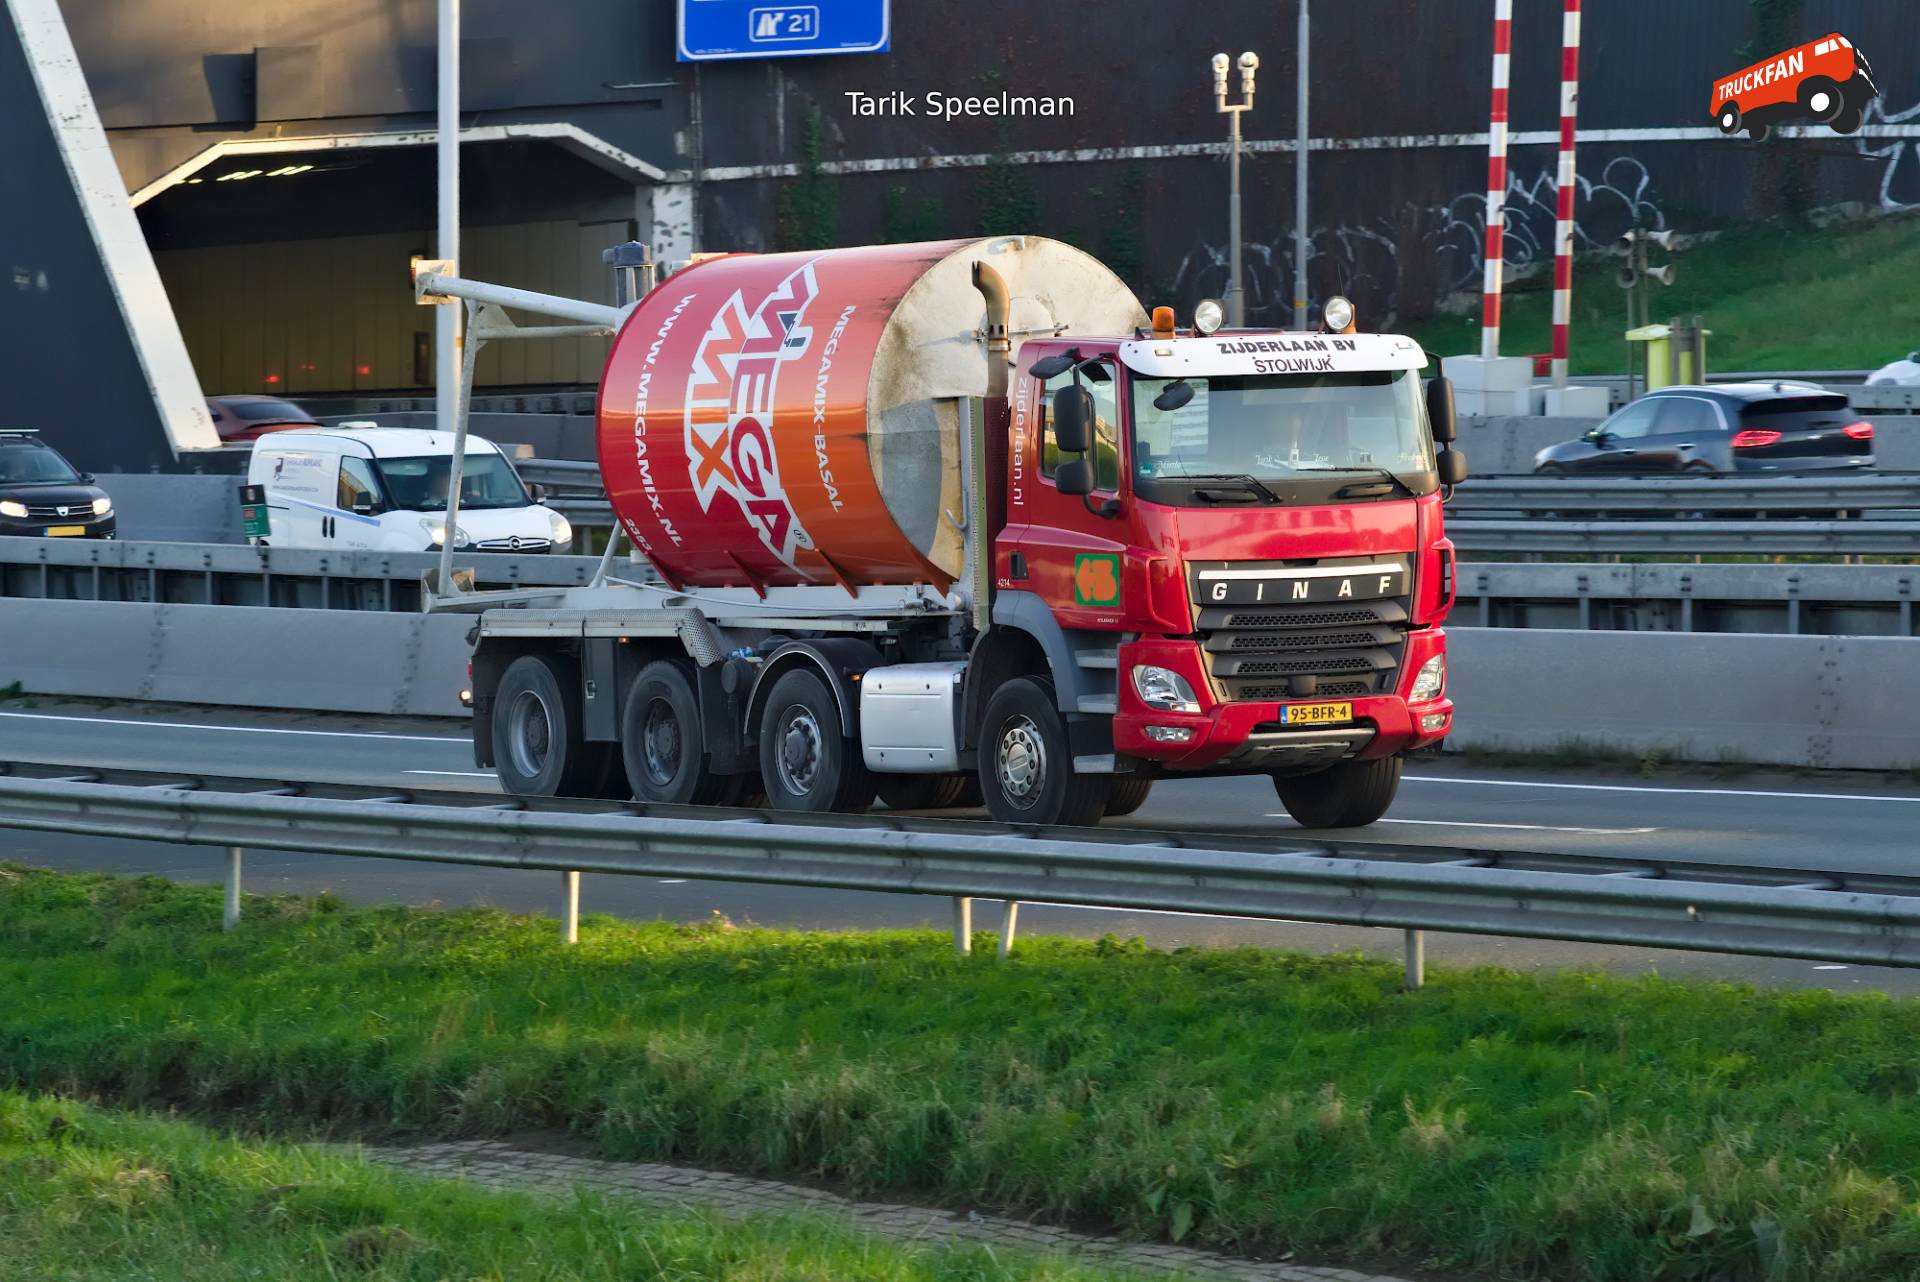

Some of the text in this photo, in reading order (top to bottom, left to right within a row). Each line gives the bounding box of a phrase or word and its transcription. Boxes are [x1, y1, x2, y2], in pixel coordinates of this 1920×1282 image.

[788, 14, 811, 33] 21
[1216, 339, 1356, 354] ZIJDERLAAN BV
[1254, 358, 1335, 373] STOLWIJK
[686, 290, 750, 514] MIX
[813, 305, 857, 513] MEGAMIX-BASAL
[634, 294, 696, 548] WWW.MEGAMIX.NL
[1013, 377, 1028, 506] zijderlaan.nl
[1212, 576, 1391, 600] GINAF
[1291, 705, 1347, 720] 95-BFR-4
